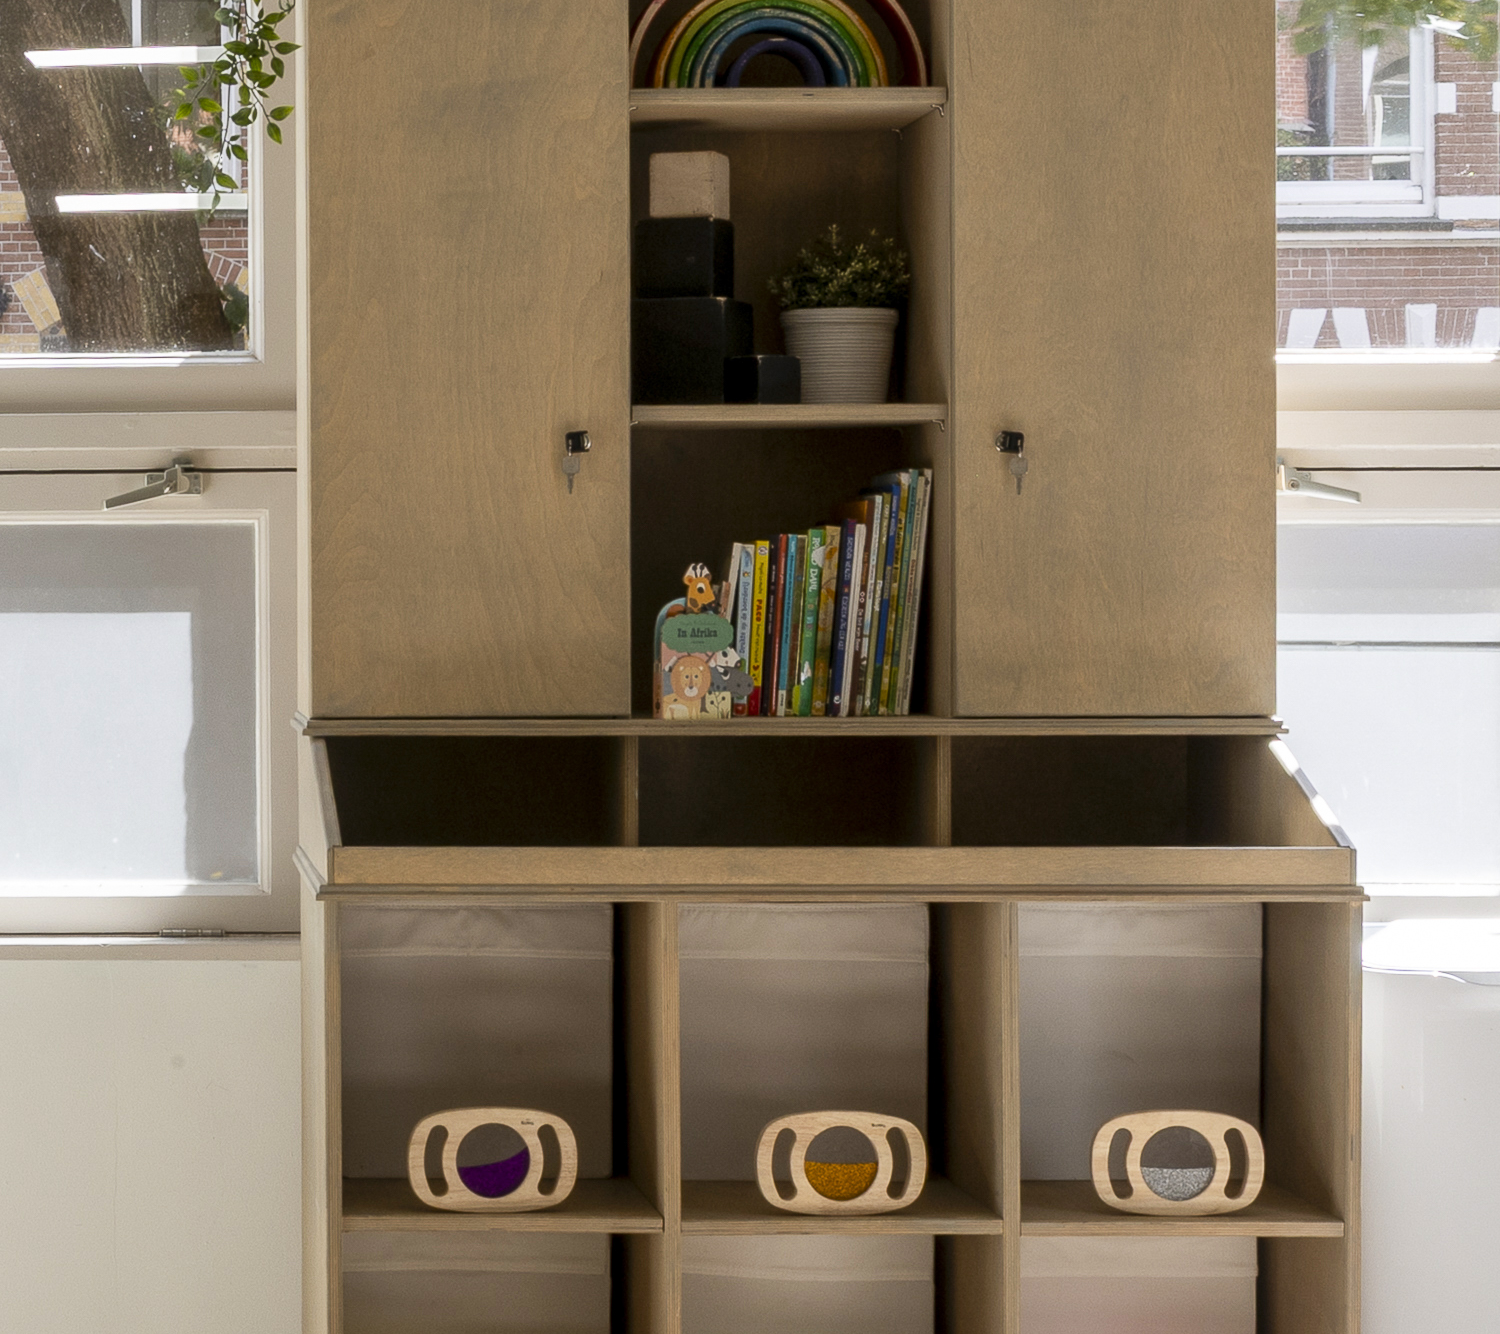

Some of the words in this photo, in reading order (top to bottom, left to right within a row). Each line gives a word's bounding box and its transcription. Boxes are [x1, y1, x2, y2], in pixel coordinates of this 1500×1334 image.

[810, 537, 821, 565] ROD
[677, 628, 687, 637] In
[690, 628, 718, 637] Afrika
